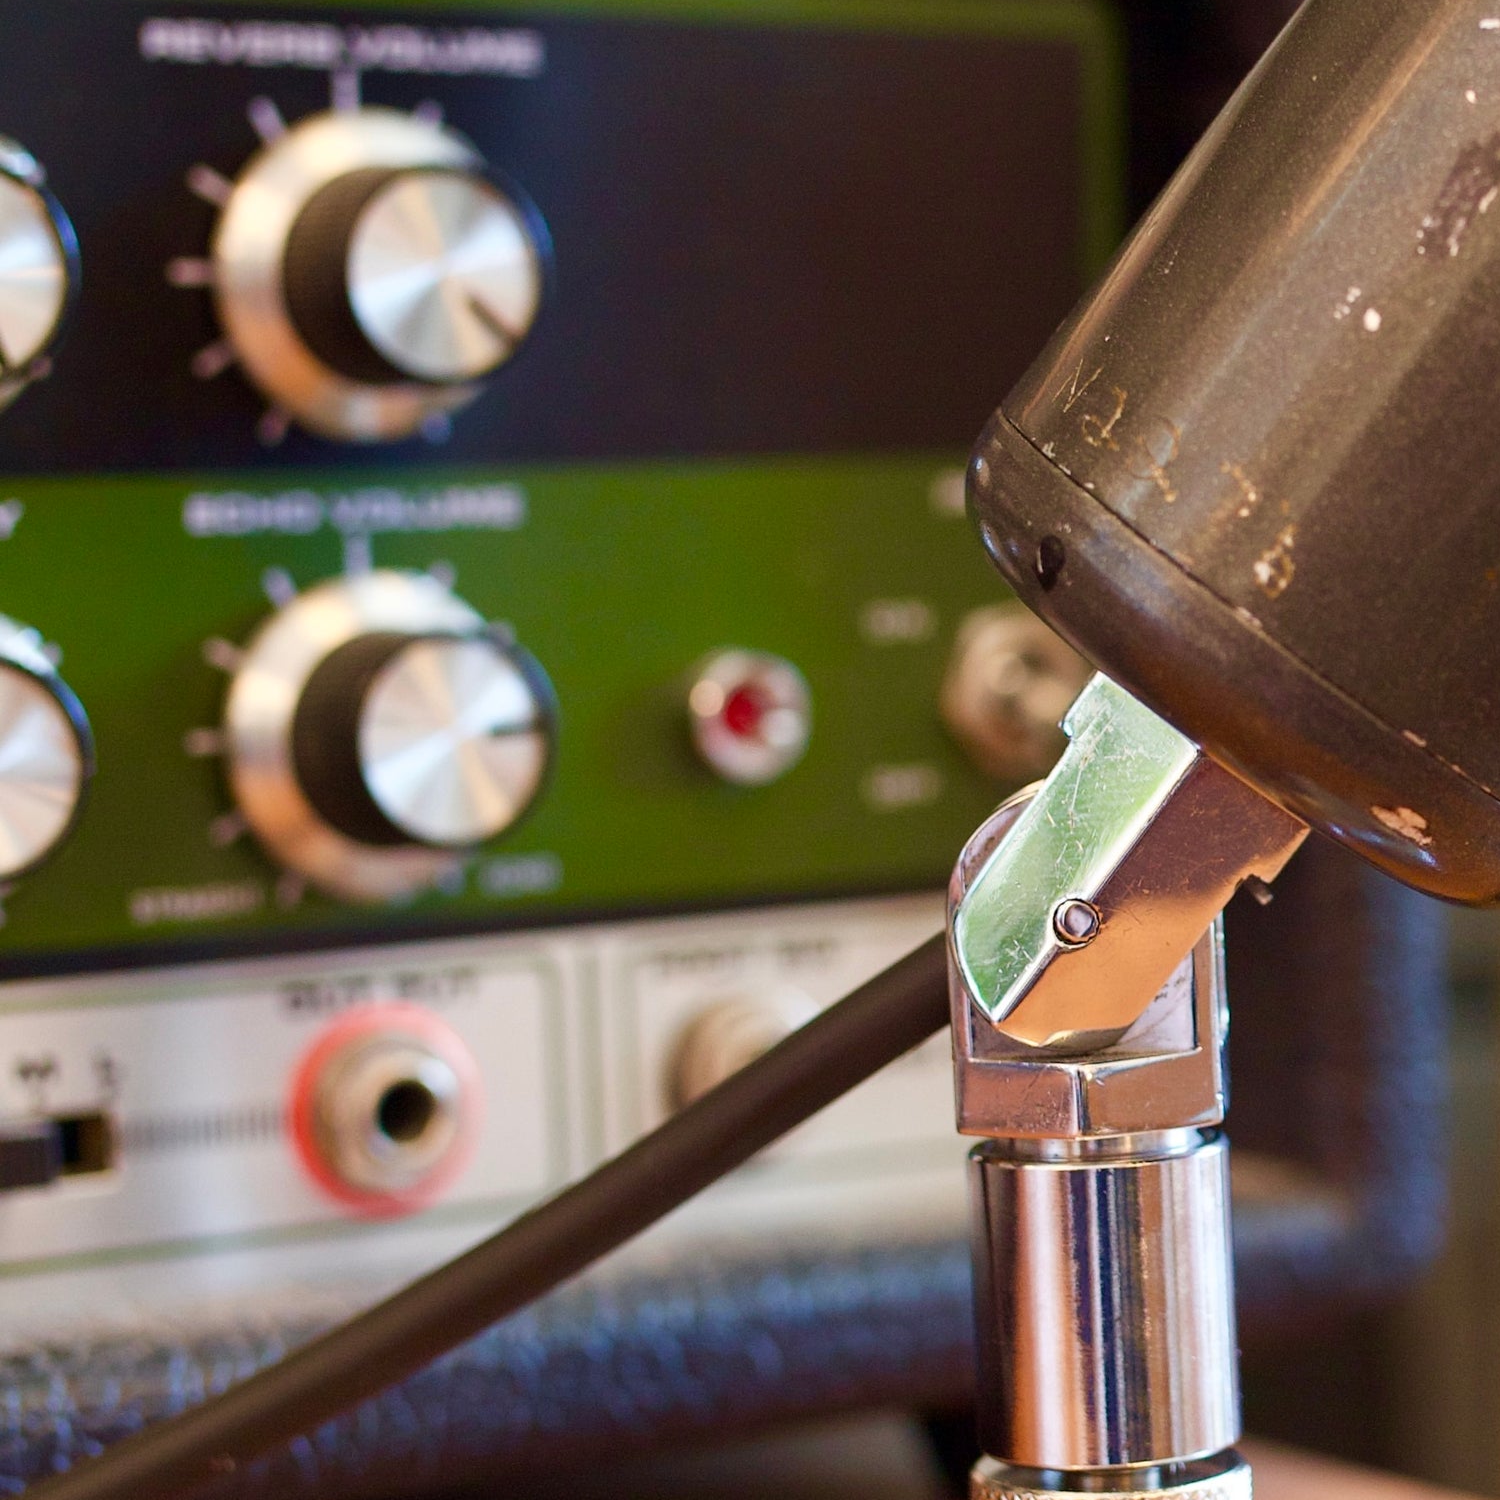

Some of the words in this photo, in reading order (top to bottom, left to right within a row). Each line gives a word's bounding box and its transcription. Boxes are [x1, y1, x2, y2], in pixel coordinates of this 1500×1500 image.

[139, 18, 340, 66] REVERB
[349, 24, 543, 76] VOLUME
[184, 492, 322, 536] ECHO
[330, 485, 524, 531] VOLUME
